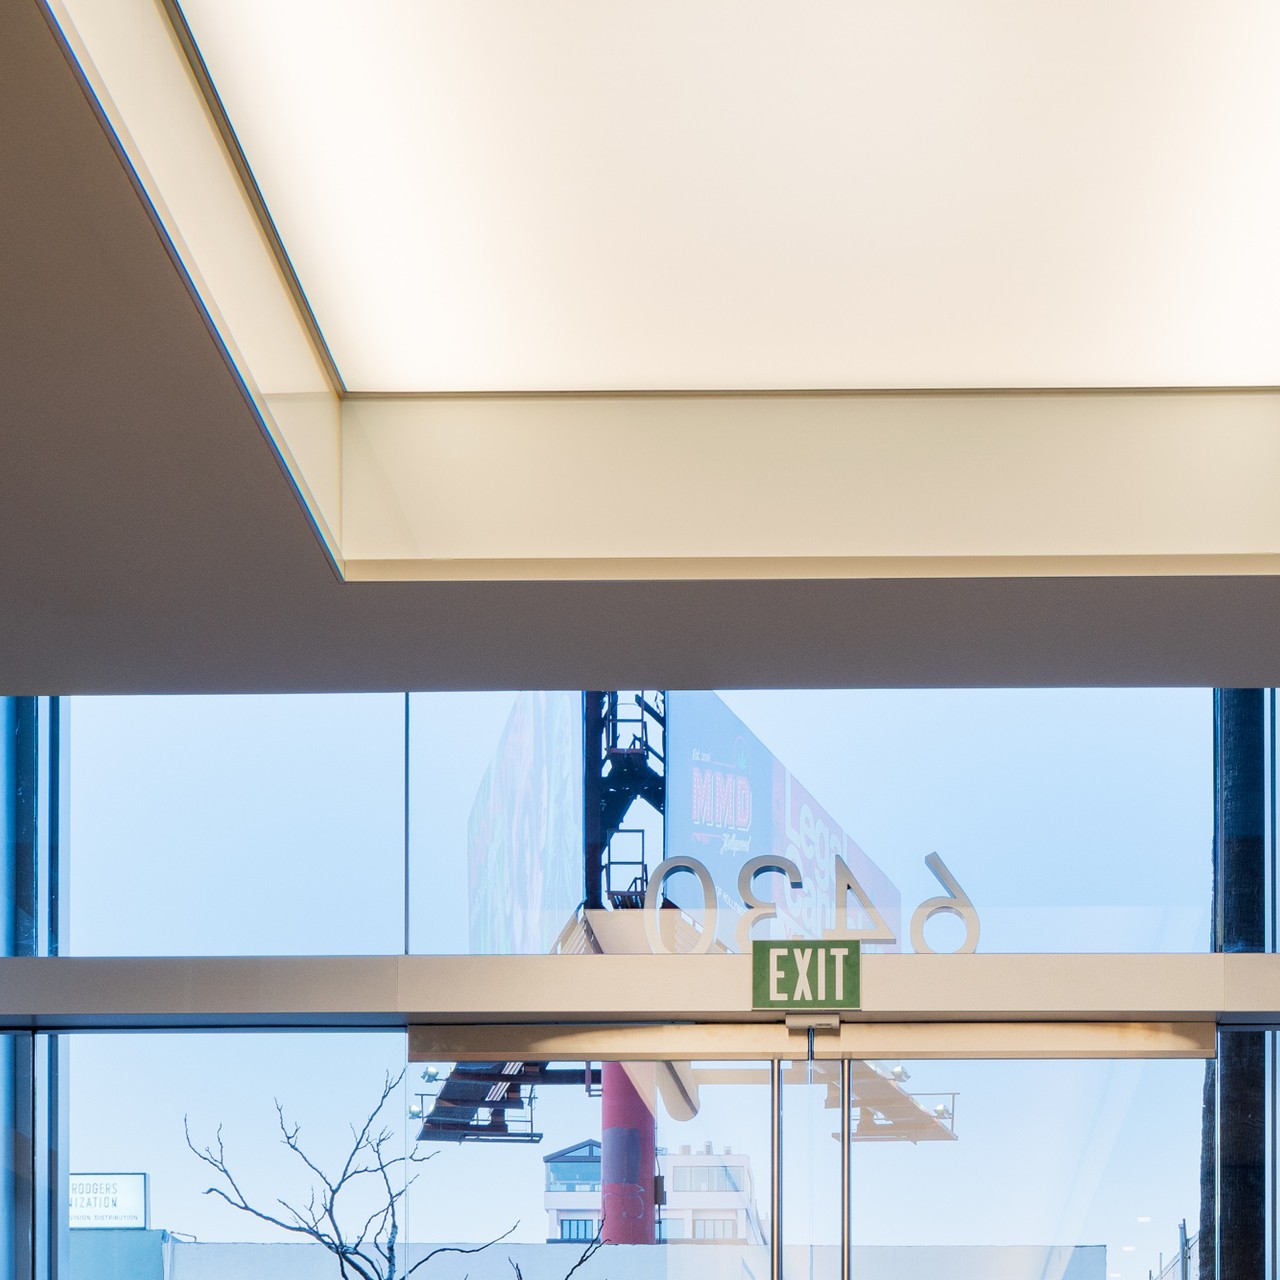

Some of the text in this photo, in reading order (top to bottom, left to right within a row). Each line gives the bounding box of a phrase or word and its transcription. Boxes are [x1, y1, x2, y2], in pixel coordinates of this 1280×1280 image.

[692, 766, 752, 832] MMD
[770, 948, 849, 1001] EXIT
[72, 1182, 118, 1194] RODGERS
